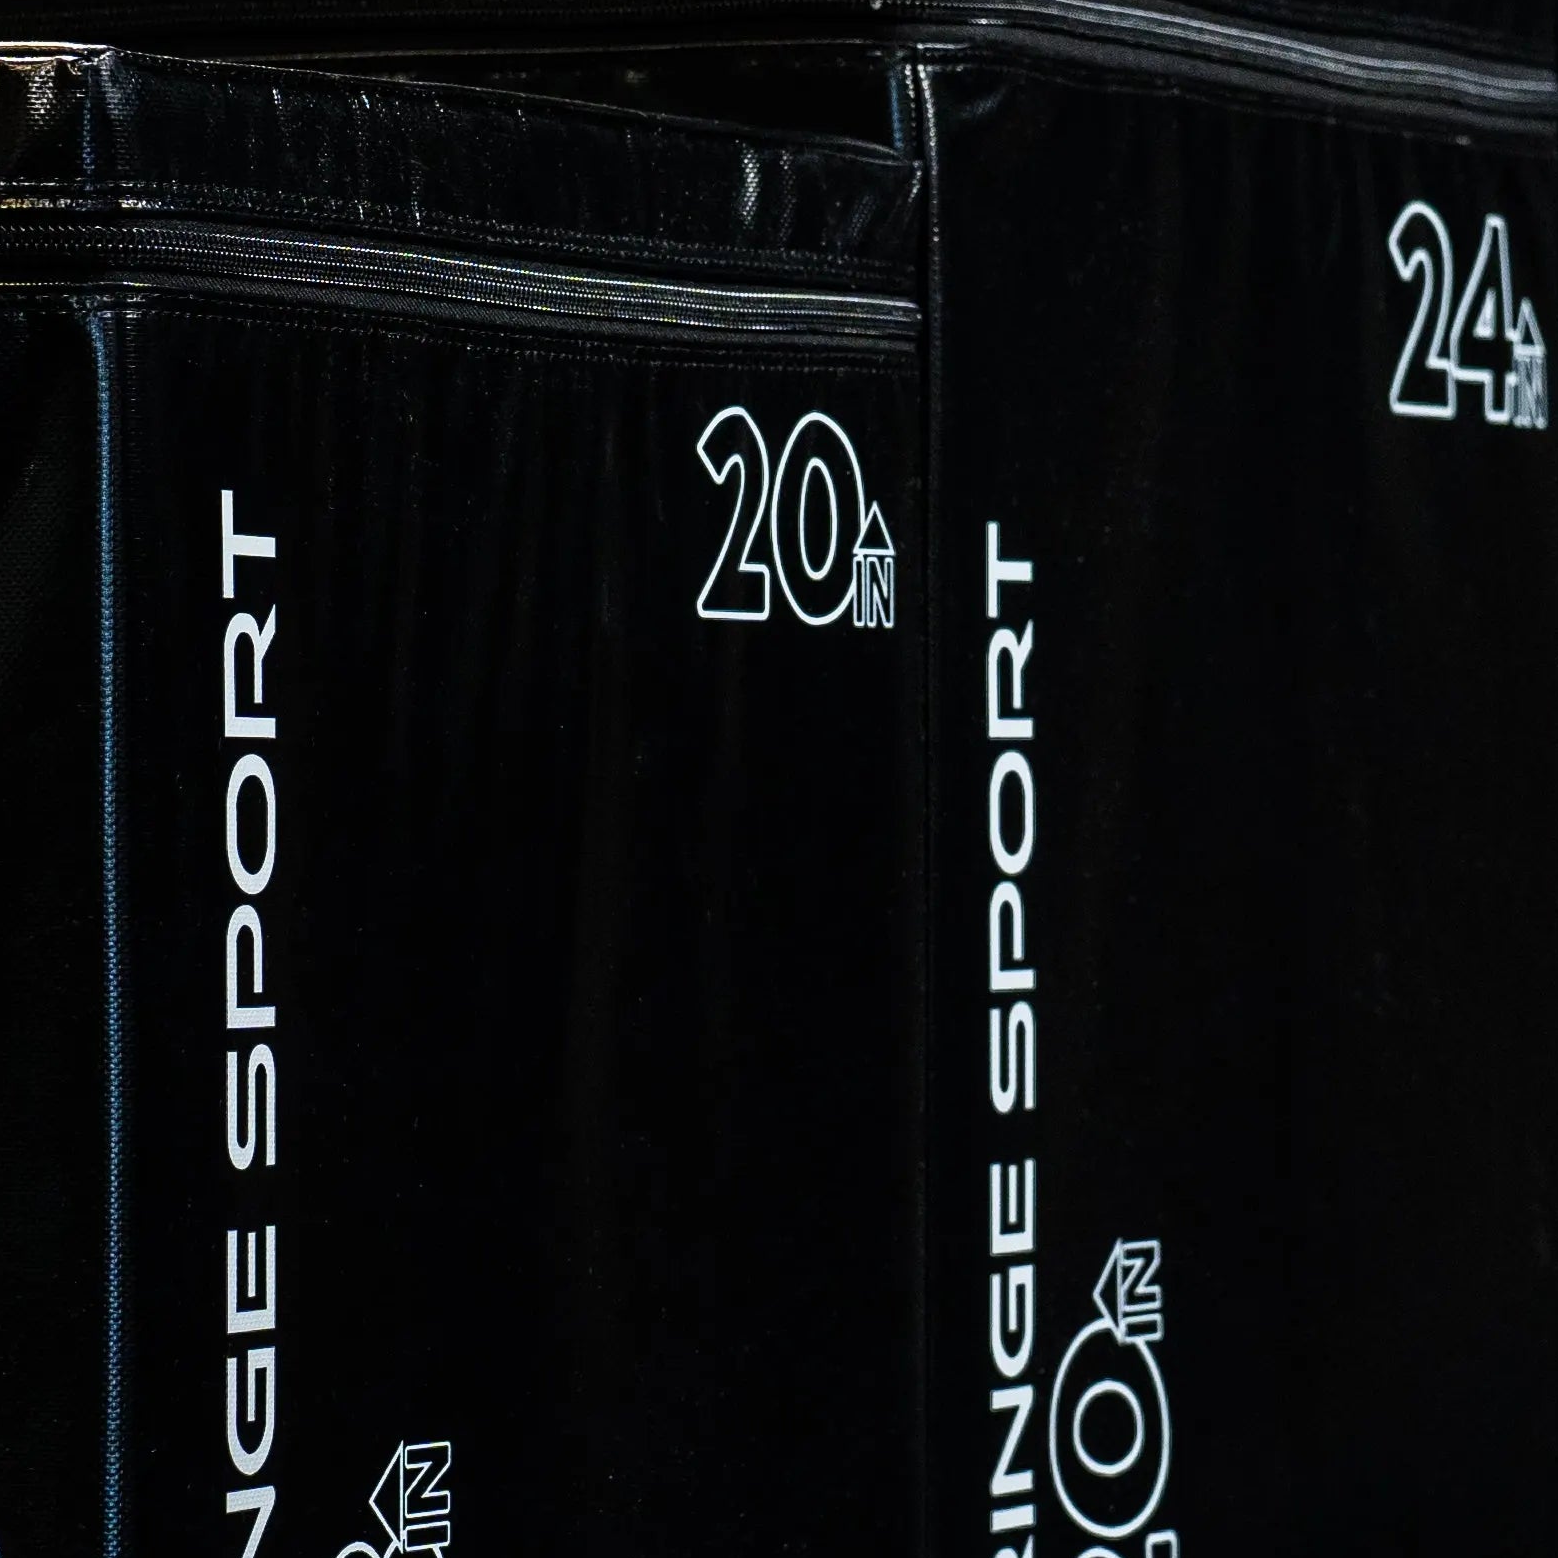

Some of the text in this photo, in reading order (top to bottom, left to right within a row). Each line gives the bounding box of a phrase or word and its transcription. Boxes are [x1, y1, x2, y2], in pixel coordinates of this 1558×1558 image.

[696, 405, 866, 626] 20
[1387, 199, 1518, 425] 24
[221, 488, 277, 1171] SPORT
[987, 520, 1035, 1114] SPORT
